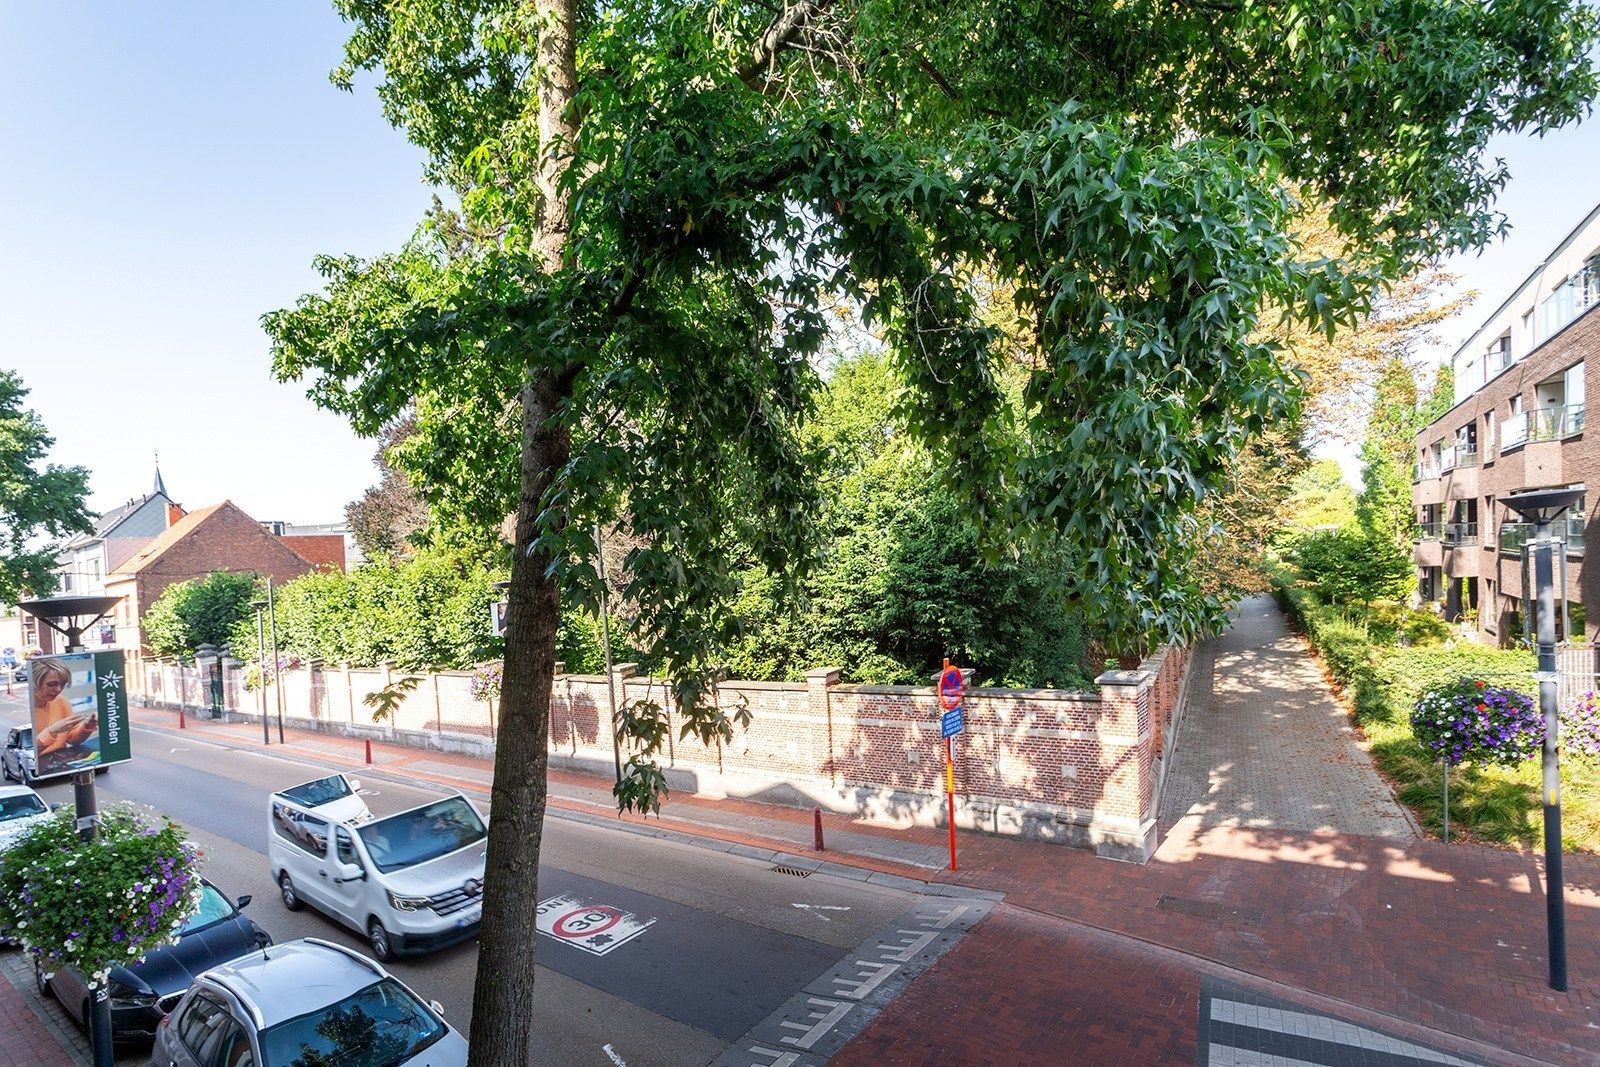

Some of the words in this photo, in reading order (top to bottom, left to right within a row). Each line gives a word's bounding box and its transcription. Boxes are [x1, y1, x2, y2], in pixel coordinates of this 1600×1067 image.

[106, 692, 121, 744] zwinkelen
[537, 896, 571, 915] ONE
[568, 912, 606, 931] 30
